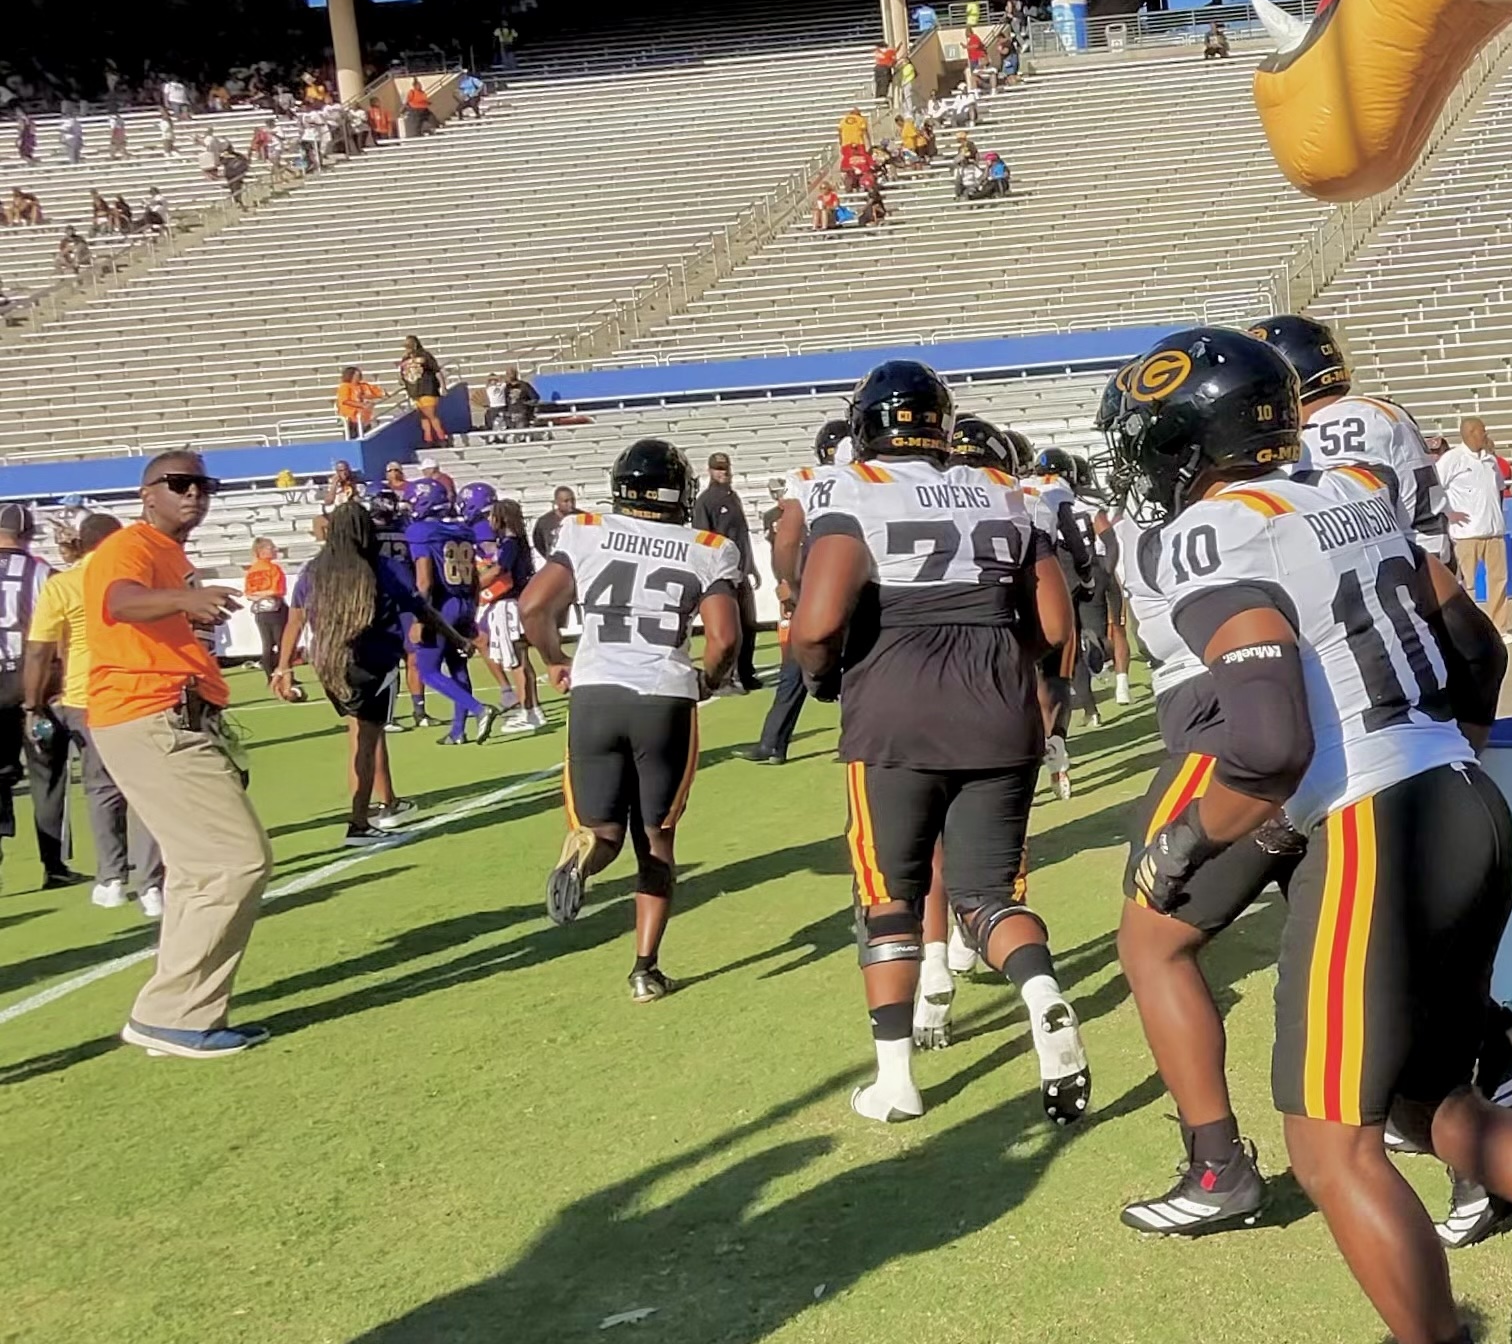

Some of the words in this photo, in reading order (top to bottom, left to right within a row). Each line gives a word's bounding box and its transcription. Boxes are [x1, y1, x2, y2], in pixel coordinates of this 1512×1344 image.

[1256, 405, 1273, 422] 10
[1319, 418, 1366, 457] 52
[916, 485, 991, 509] OWENS
[600, 531, 690, 563] JOHNSON
[1302, 494, 1398, 553] ROBINSON
[1171, 523, 1222, 586] 10
[584, 558, 703, 649] 43
[1331, 556, 1452, 734] 10
